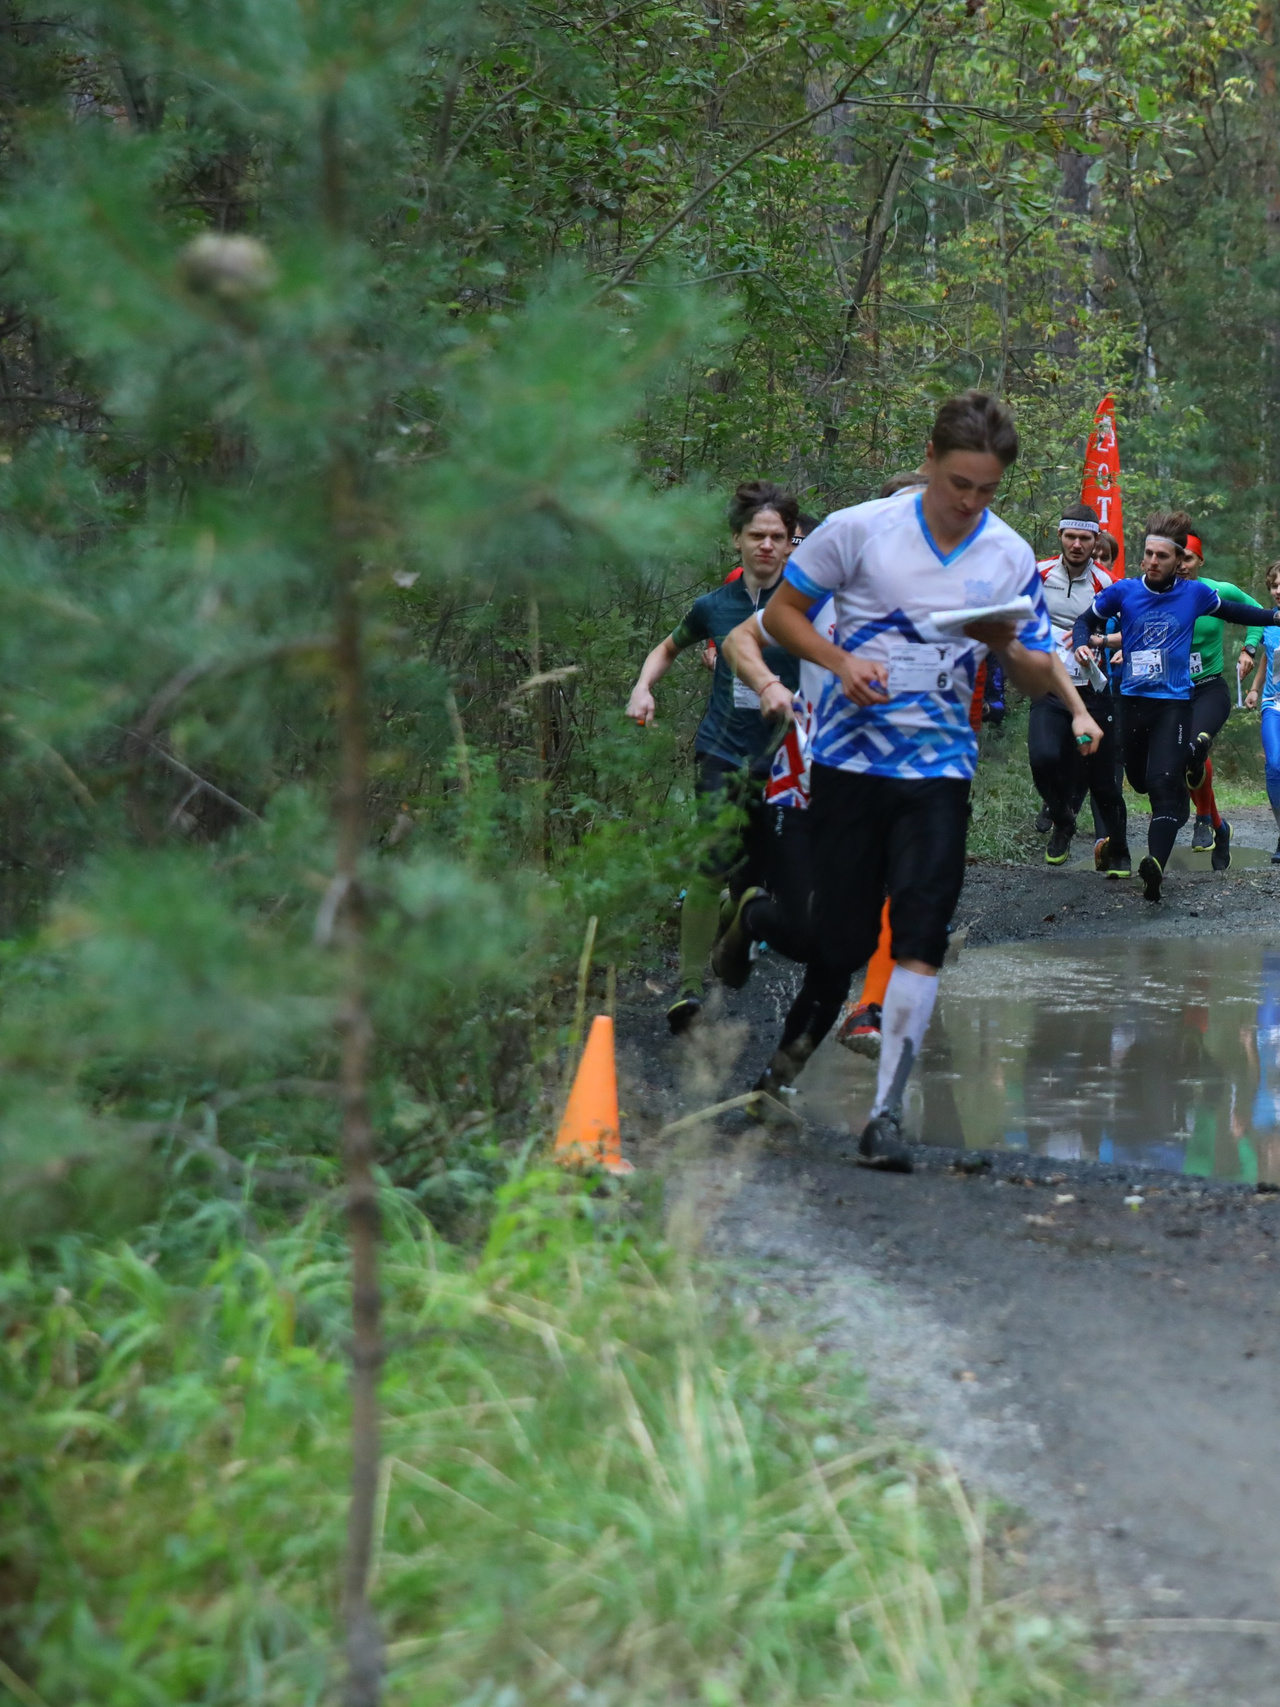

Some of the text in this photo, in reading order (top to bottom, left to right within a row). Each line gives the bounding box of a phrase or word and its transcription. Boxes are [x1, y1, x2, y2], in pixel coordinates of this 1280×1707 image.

[1148, 663, 1161, 673] 33
[1190, 665, 1201, 674] 13
[937, 671, 948, 689] 6
